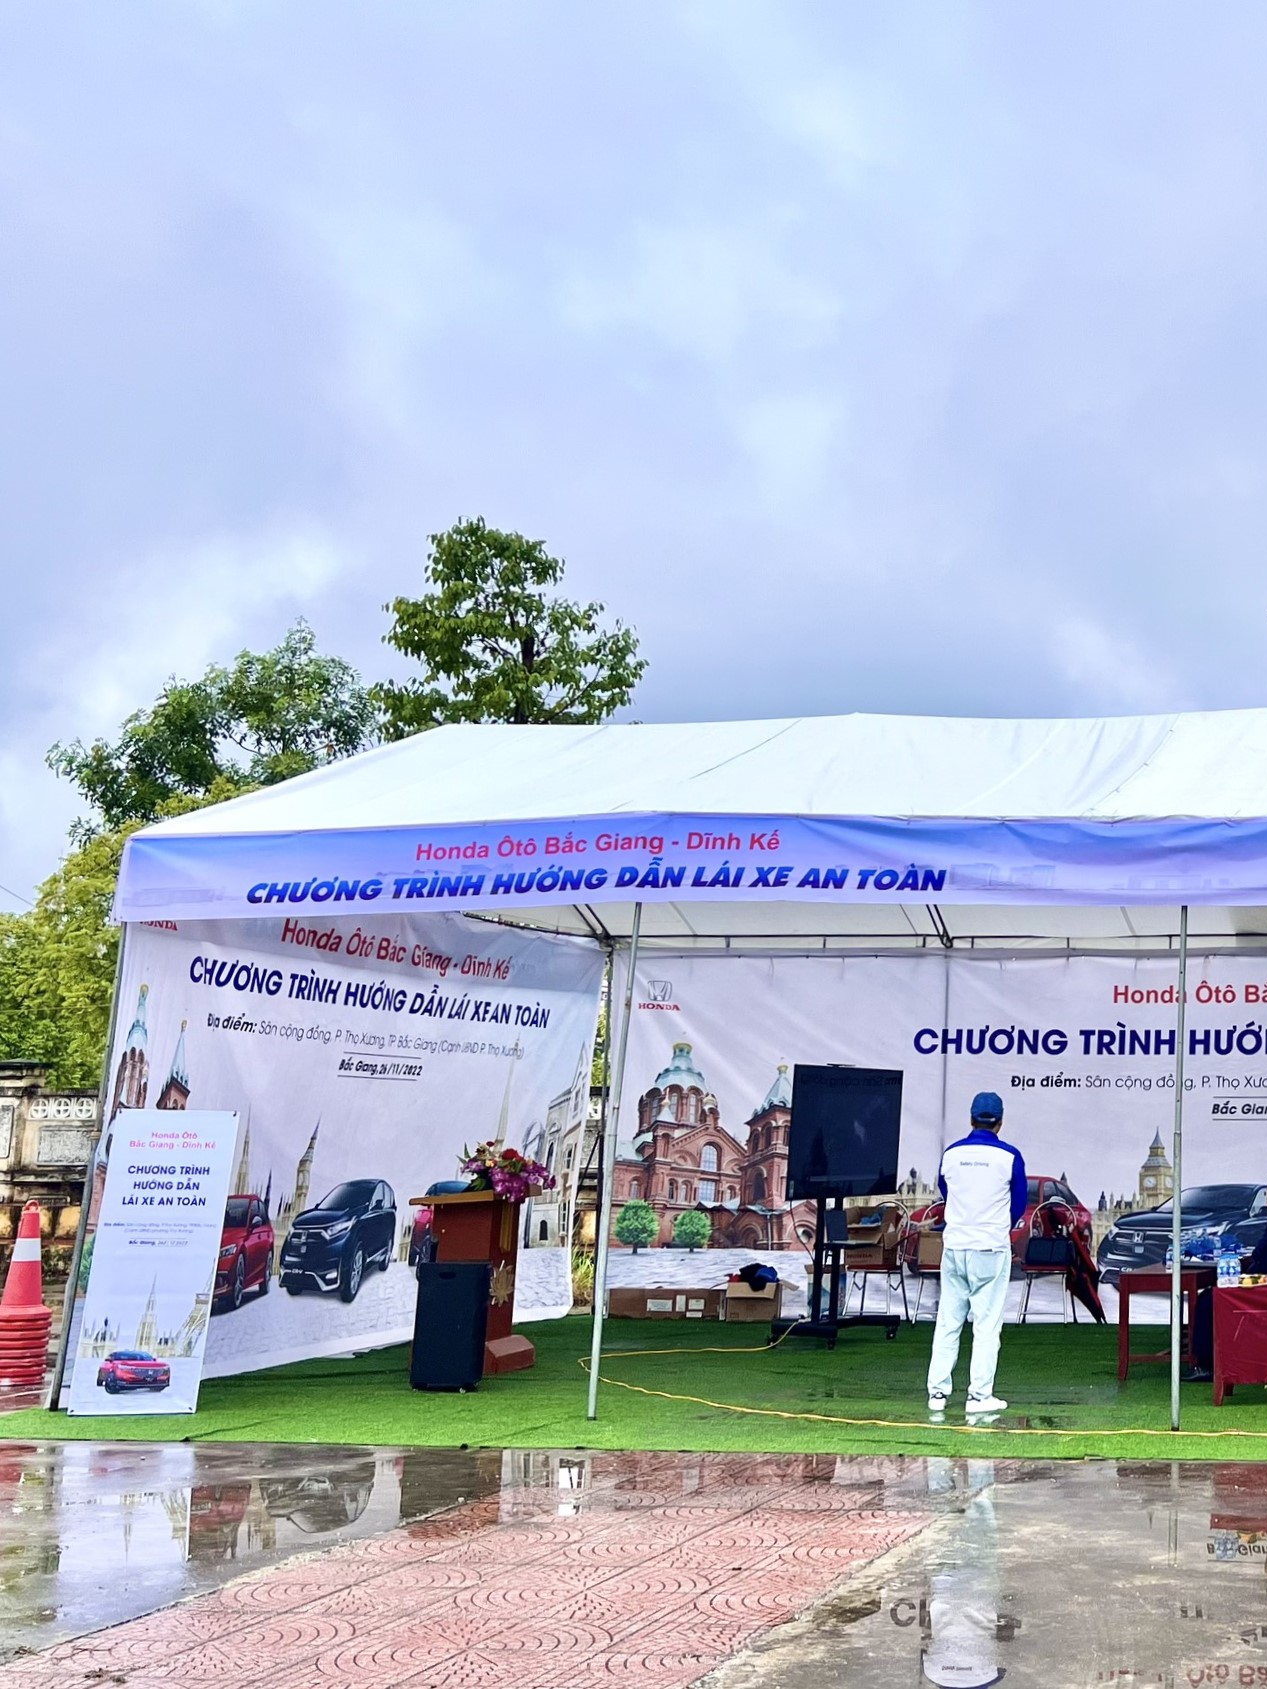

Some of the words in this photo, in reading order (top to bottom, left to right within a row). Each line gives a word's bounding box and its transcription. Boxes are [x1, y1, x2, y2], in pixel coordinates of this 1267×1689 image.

[416, 842, 489, 861] Honda
[498, 835, 537, 858] Ôtô
[545, 831, 587, 855] Bắc
[595, 833, 664, 855] Giang
[687, 831, 741, 850] Dĩnh
[749, 829, 780, 850] Kế
[247, 876, 384, 904] CHƯƠNG
[392, 871, 486, 899] TRÌNH
[490, 864, 608, 896] HƯỚNG
[614, 857, 687, 889] DẪN
[691, 860, 746, 888] LÁI
[748, 866, 794, 888] XE
[796, 868, 849, 889] AN
[856, 863, 947, 892] TOÀN
[143, 920, 178, 931] ONDA
[281, 918, 342, 952] Honda
[346, 927, 374, 958] Ôtô
[377, 934, 407, 963] Bắc
[411, 943, 451, 977] Giang
[460, 953, 493, 978] Dĩnh
[493, 955, 511, 980] Kế
[190, 956, 283, 996] CHƯƠNG
[287, 969, 342, 1005] TRÌNH
[343, 979, 408, 1012] HƯỚNG
[408, 984, 449, 1018] DẪN
[447, 993, 470, 1020] LÁI
[514, 1001, 551, 1028] TOÀN
[1113, 985, 1187, 1004] Honda
[1196, 980, 1236, 1004] Ôtô
[638, 1002, 681, 1011] HONDA
[914, 1024, 1068, 1055] CHƯƠNG
[1079, 1021, 1176, 1056] TRÌNH
[1011, 1075, 1035, 1091] Địa
[1040, 1071, 1082, 1088] điểm:
[1085, 1074, 1111, 1088] Sân
[1115, 1075, 1152, 1092] cộng
[1156, 1071, 1196, 1092] đồg,
[1201, 1076, 1211, 1089] P.
[1216, 1075, 1240, 1093] Thọ
[1211, 1101, 1238, 1116] Bắc
[151, 1132, 180, 1140] Honda
[148, 1141, 175, 1150] Giang
[127, 1164, 177, 1176] CHƯƠNG
[180, 1164, 210, 1176] TRÌNH
[133, 1178, 173, 1191] HƯỚNG
[122, 1194, 138, 1206] LÁI
[141, 1196, 155, 1206] XE
[157, 1196, 174, 1206] AN
[177, 1194, 206, 1207] TOÀN
